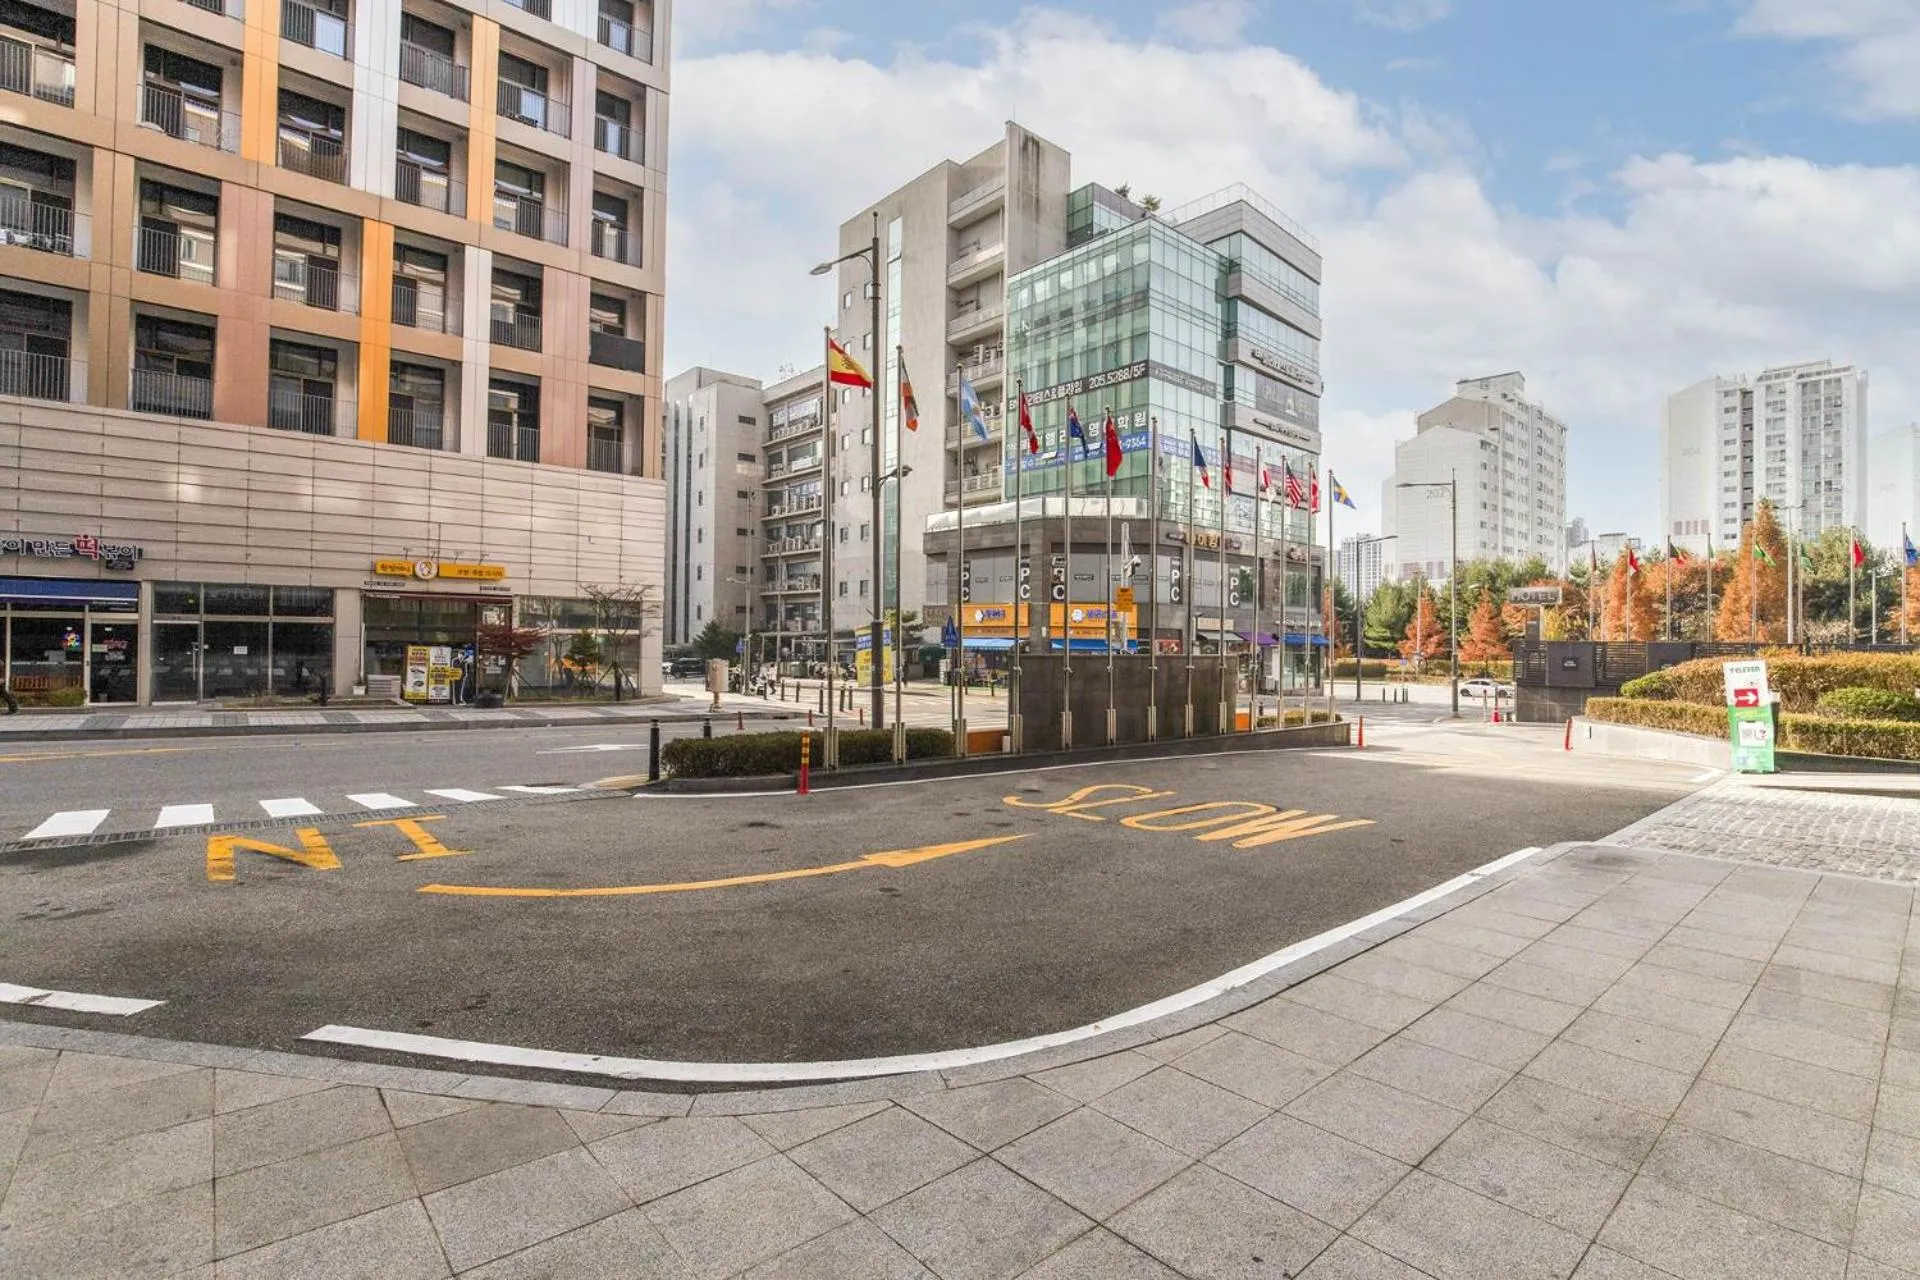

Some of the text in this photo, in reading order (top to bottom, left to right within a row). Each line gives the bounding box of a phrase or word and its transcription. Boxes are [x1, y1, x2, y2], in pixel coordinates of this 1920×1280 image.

[31, 539, 73, 558] 만든
[74, 534, 139, 561] 떡볶이
[1020, 567, 1030, 600] PC
[1170, 569, 1180, 602] PC
[1229, 576, 1240, 606] PC
[1510, 591, 1556, 601] HOTEL
[1002, 784, 1377, 848] SLOW
